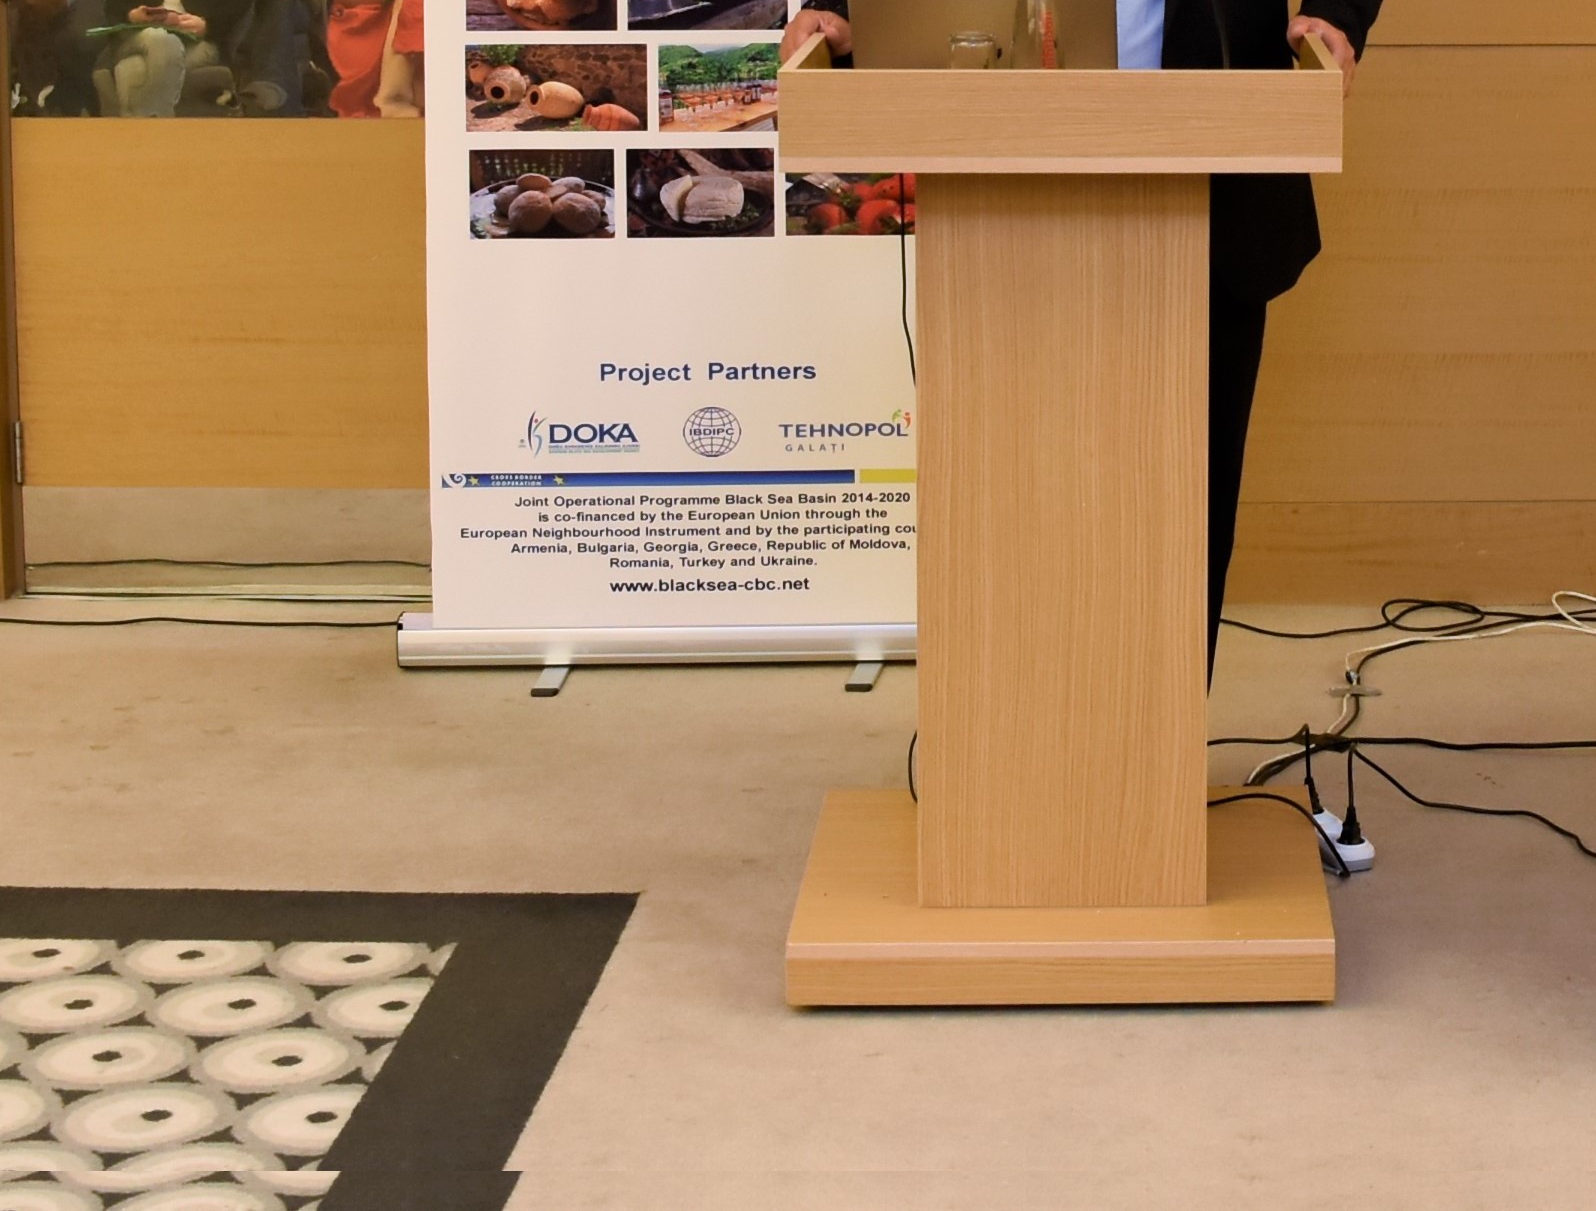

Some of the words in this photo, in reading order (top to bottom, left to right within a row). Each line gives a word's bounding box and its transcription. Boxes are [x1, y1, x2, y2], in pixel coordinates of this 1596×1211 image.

[599, 363, 692, 386] Project
[708, 361, 818, 381] Partners
[548, 423, 639, 444] DOKA
[689, 427, 735, 436] IBDIPC
[778, 422, 909, 438] TEHNOPOL
[514, 496, 549, 507] Joint
[554, 495, 635, 508] Operational
[640, 494, 720, 508] Programme
[725, 494, 763, 504] Black
[767, 493, 793, 504] Sea
[799, 493, 837, 504] Basin
[841, 492, 911, 503] 2014-2020
[538, 512, 549, 522] is
[554, 511, 635, 522] co-financed
[640, 511, 656, 523] by
[661, 511, 683, 521] the
[688, 510, 755, 522] European
[760, 509, 800, 520] Union
[805, 508, 860, 521] through
[865, 508, 888, 518] the
[460, 528, 527, 540] European
[532, 527, 641, 540] Neighbourhood
[645, 525, 721, 537] Instrument
[725, 525, 751, 535] and
[755, 525, 772, 537] by
[777, 524, 799, 535] the
[804, 524, 890, 537] participating
[511, 543, 573, 555] Armenia,
[577, 542, 639, 555] Bulgaria,
[643, 541, 703, 554] Georgia,
[707, 541, 762, 552] Greece,
[766, 540, 827, 552] Republic
[831, 539, 846, 550] of
[849, 539, 911, 550] Moldova,
[609, 558, 674, 569] Romania,
[679, 556, 725, 569] Turkey
[730, 556, 756, 567] and
[760, 556, 818, 567] Ukraine.
[609, 577, 810, 592] www.blacksea-cbc.net
